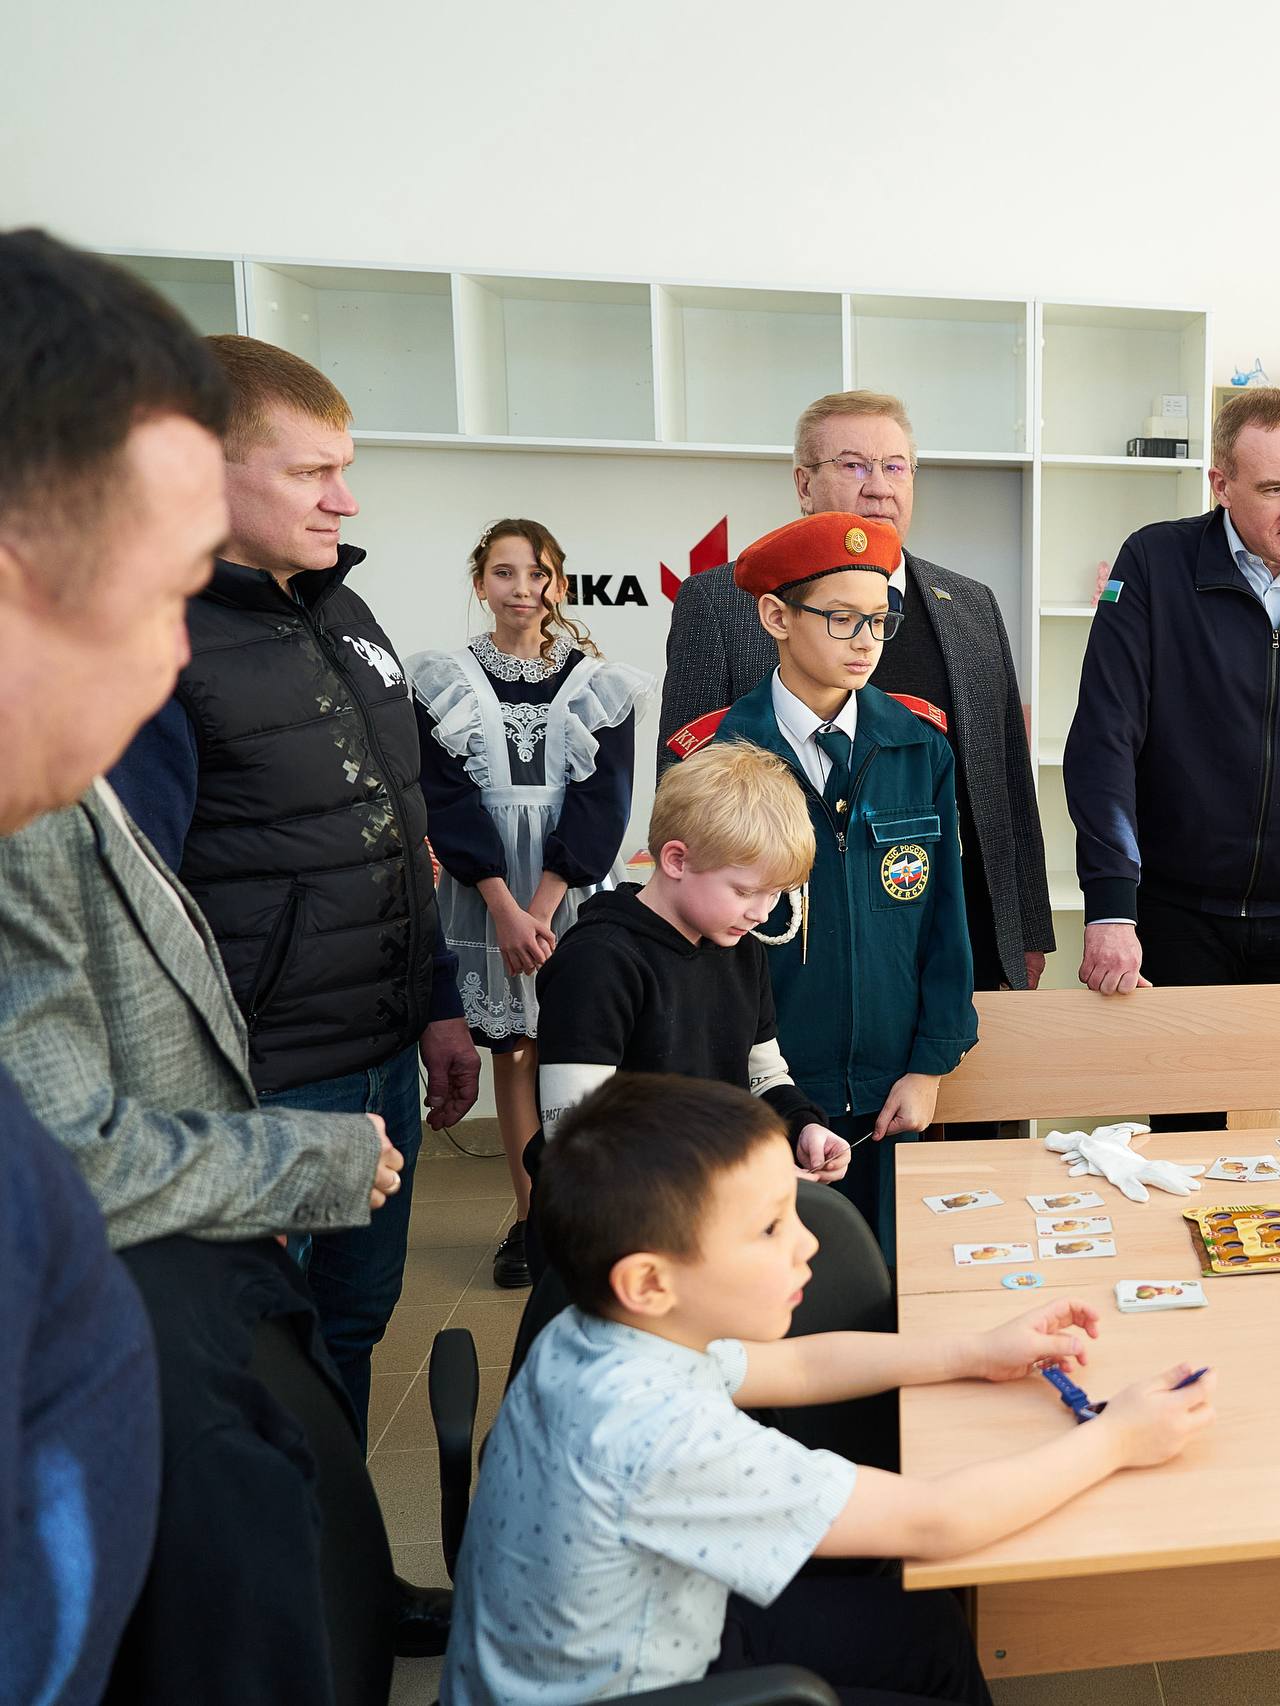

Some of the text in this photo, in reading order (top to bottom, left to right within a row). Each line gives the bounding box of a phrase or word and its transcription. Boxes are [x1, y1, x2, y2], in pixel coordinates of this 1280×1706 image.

[884, 845, 928, 866] МЧС РОССИИ
[885, 874, 928, 898] EMERCOM
